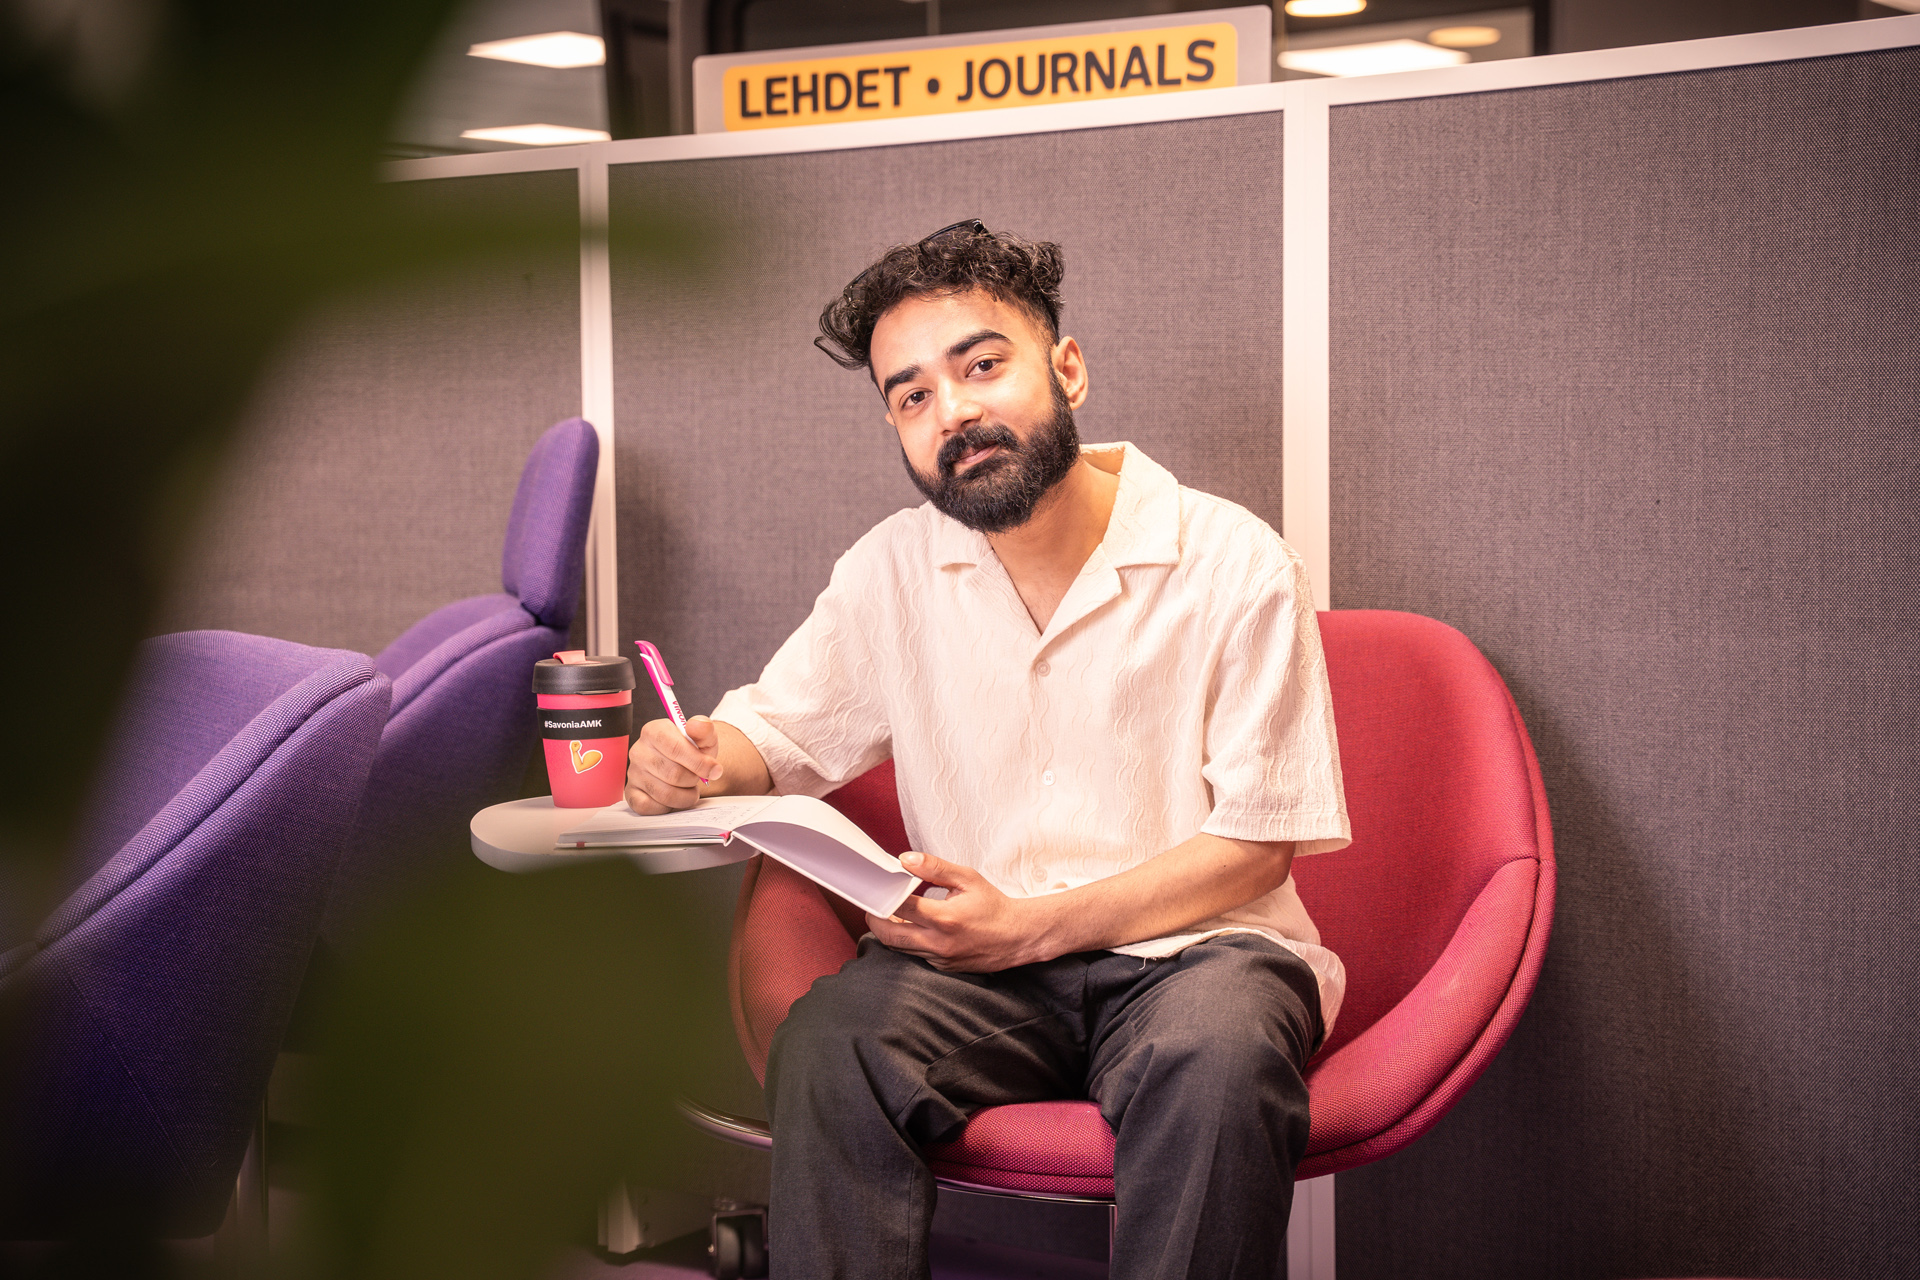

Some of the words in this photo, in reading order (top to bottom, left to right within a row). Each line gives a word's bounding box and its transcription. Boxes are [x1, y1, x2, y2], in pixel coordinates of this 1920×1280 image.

[739, 66, 910, 118] LEHDET
[957, 39, 1216, 102] JOURNALS
[544, 719, 602, 729] #SavoniaAMK
[672, 700, 687, 729] VONIA
